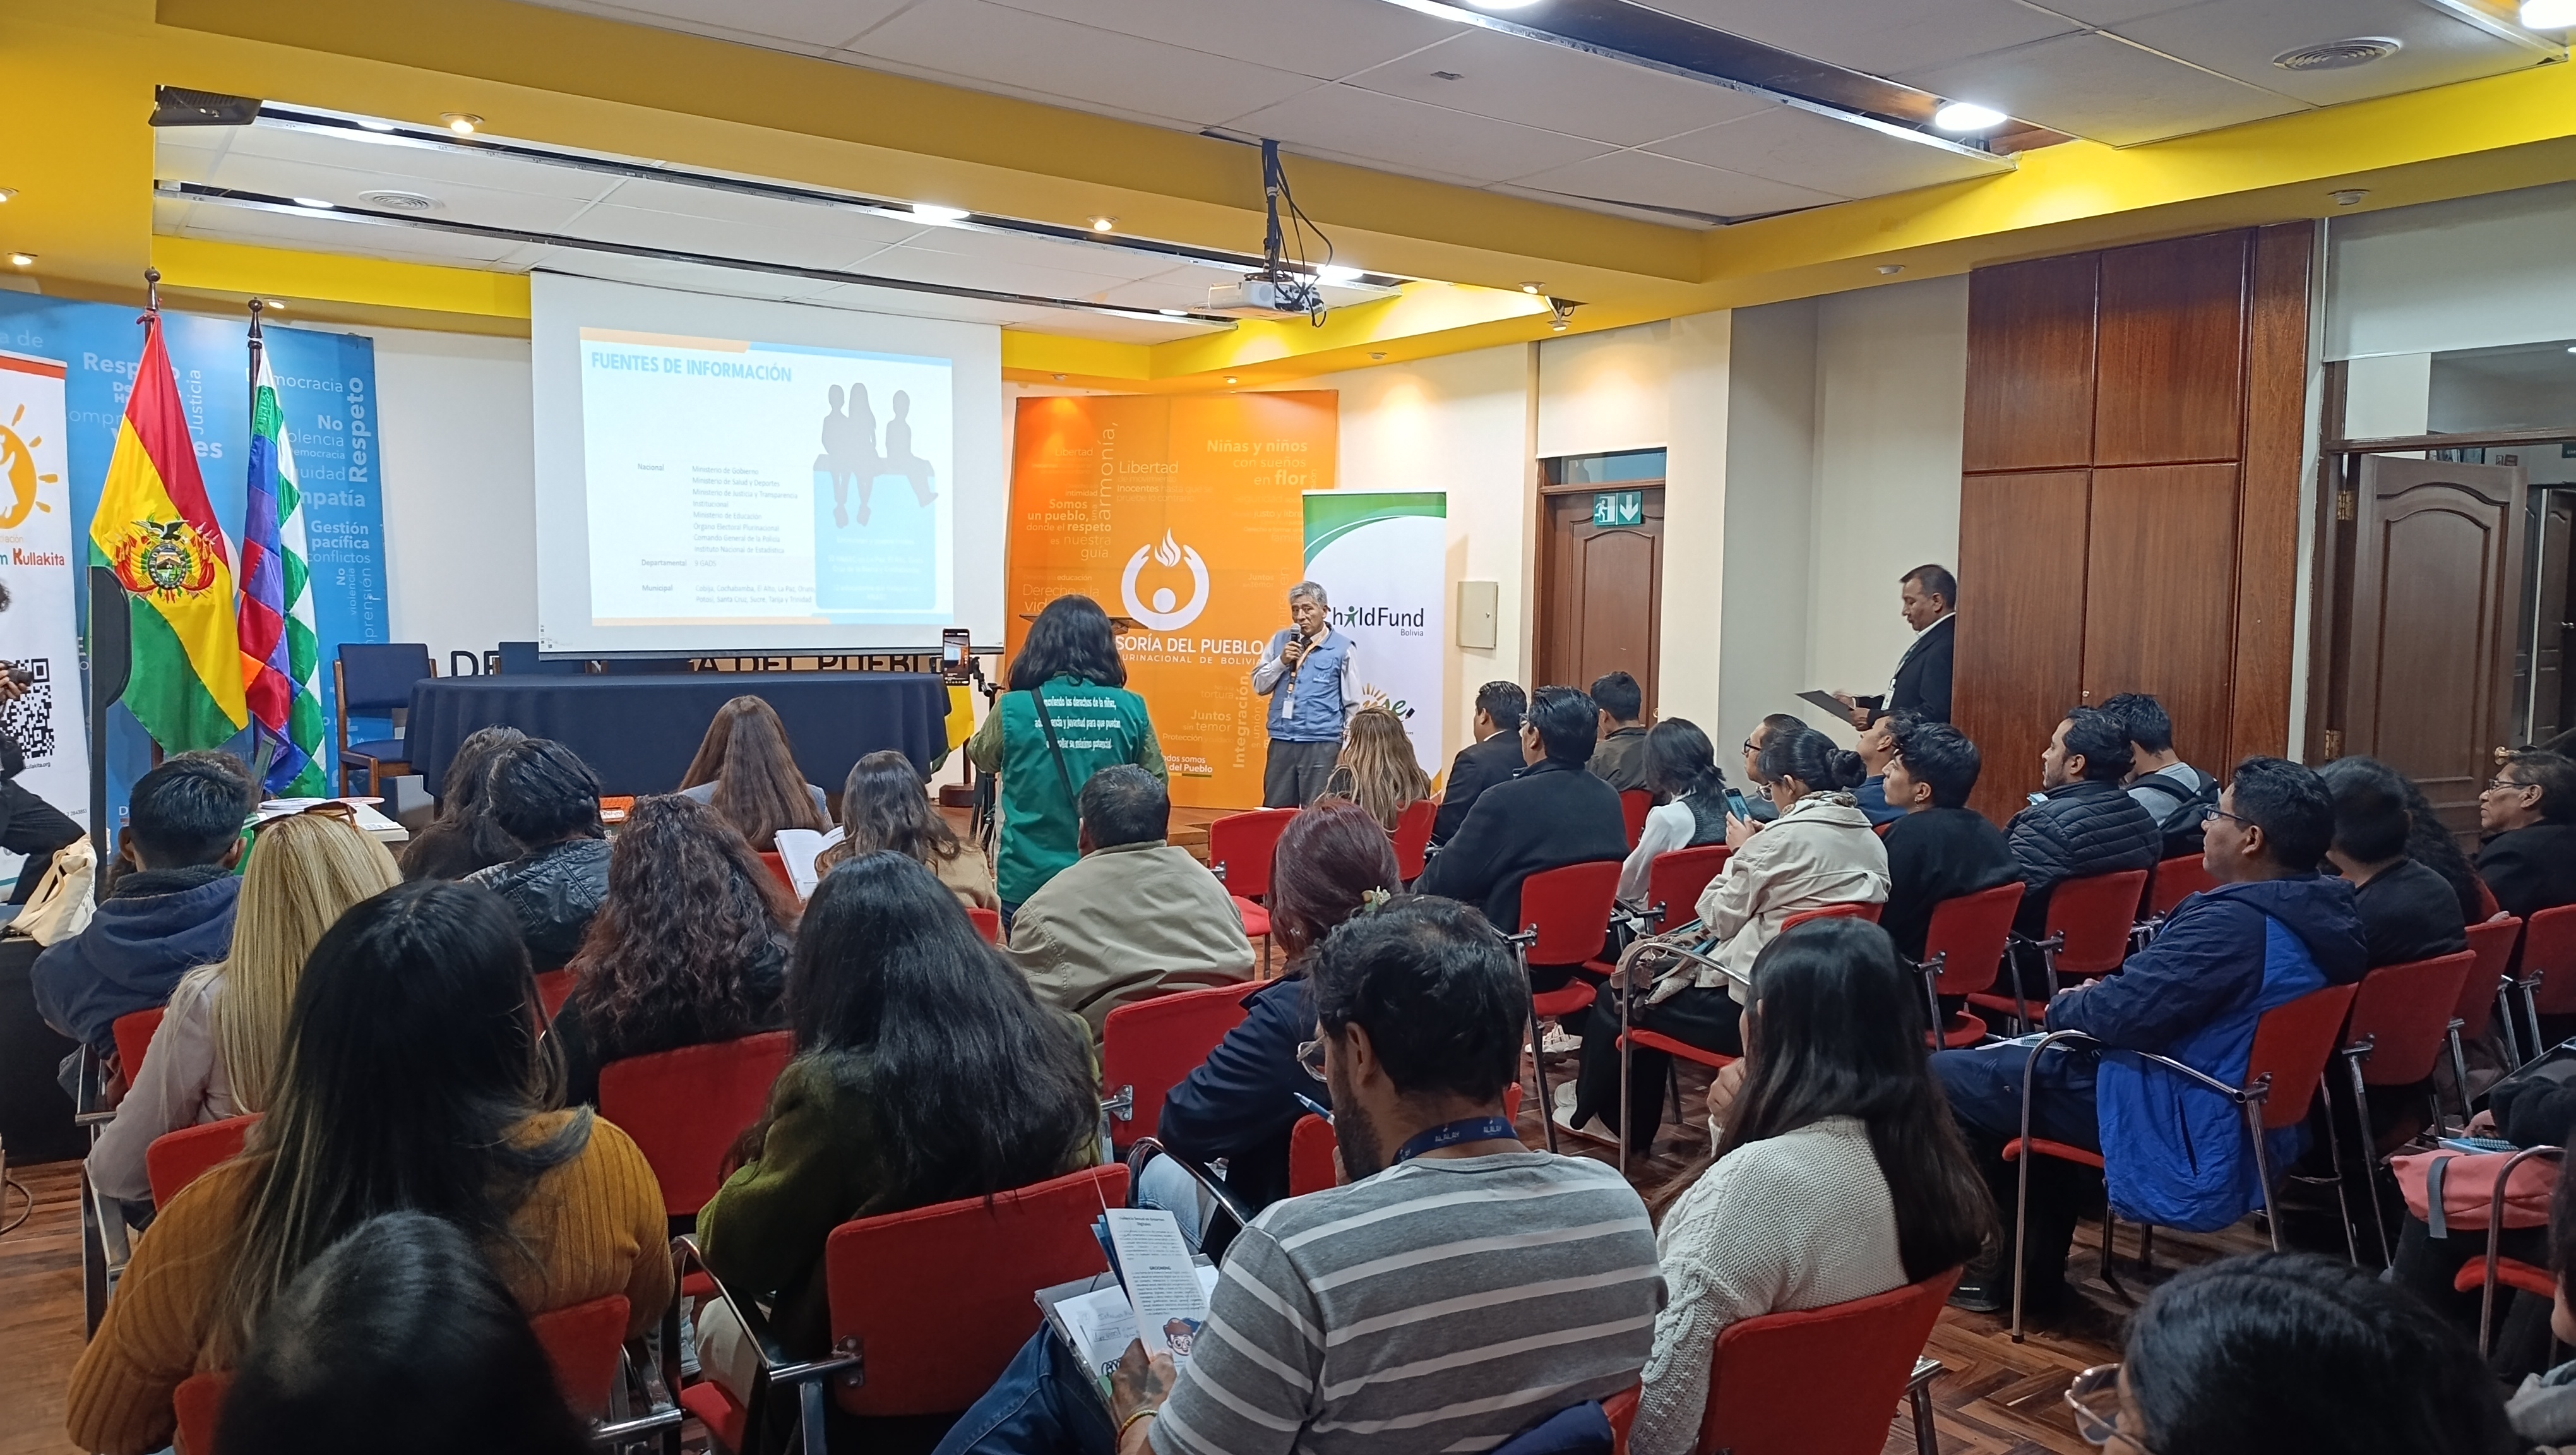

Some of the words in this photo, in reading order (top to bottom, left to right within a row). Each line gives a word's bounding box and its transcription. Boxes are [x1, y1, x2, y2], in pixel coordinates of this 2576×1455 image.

[83, 352, 181, 381] Respo
[592, 352, 659, 373] FUENTES
[664, 357, 682, 374] DE
[687, 359, 792, 382] INFORMACIÓN
[189, 369, 203, 435] Justicia
[318, 414, 343, 431] No
[347, 377, 371, 482] Respeto
[289, 429, 343, 446] olencia
[293, 447, 345, 459] emocracia
[1055, 447, 1093, 456] Libertad
[1207, 439, 1249, 452] Niñas
[1253, 443, 1262, 456] y
[1267, 439, 1308, 452] niños
[1119, 460, 1179, 474] Libertad
[1233, 459, 1256, 467] con
[1261, 456, 1306, 467] sueños
[300, 465, 345, 481] uidad
[692, 465, 722, 474] Ministerio
[1097, 422, 1118, 520] armonía,
[1254, 477, 1270, 485] en
[1275, 469, 1307, 485] flor
[300, 489, 365, 510] mpatía
[693, 489, 722, 497] Ministerio
[760, 491, 797, 500] Transparencia
[1049, 498, 1088, 509] Somos
[1027, 512, 1041, 520] un
[1045, 510, 1088, 523] pueblo,
[1254, 510, 1275, 518] justo
[311, 520, 369, 535] Gestión
[1027, 522, 1054, 531] donde
[1057, 522, 1064, 531] el
[1068, 522, 1112, 534] respeto
[311, 536, 370, 551] pacífica
[1064, 536, 1111, 546] nuestra
[13, 548, 65, 566] Kullakita
[337, 568, 345, 585] No
[347, 568, 355, 616] violencia
[1023, 584, 1076, 596] Derecho
[1090, 585, 1099, 597] la
[1025, 598, 1047, 612] vid
[1328, 606, 1424, 628] hildFund
[1115, 633, 1162, 652] SORÍA
[1167, 637, 1196, 653] DEL
[1201, 639, 1263, 656] PUEBLO
[1123, 654, 1192, 663] URINACIONAL
[1073, 696, 1092, 707] derechos
[1093, 697, 1098, 707] de
[1099, 697, 1104, 707] la
[1201, 690, 1234, 699] tortura
[1191, 709, 1231, 721] Juntos
[1233, 671, 1251, 768] Integración,
[1063, 719, 1066, 729] y
[1067, 716, 1086, 729] juventud
[1087, 719, 1096, 730] para
[1196, 721, 1232, 732] temor
[1252, 707, 1261, 739] unión
[1162, 733, 1203, 741] Protección
[1163, 754, 1180, 762] odos
[1169, 763, 1182, 771] del
[1184, 763, 1213, 773] Pueblo
